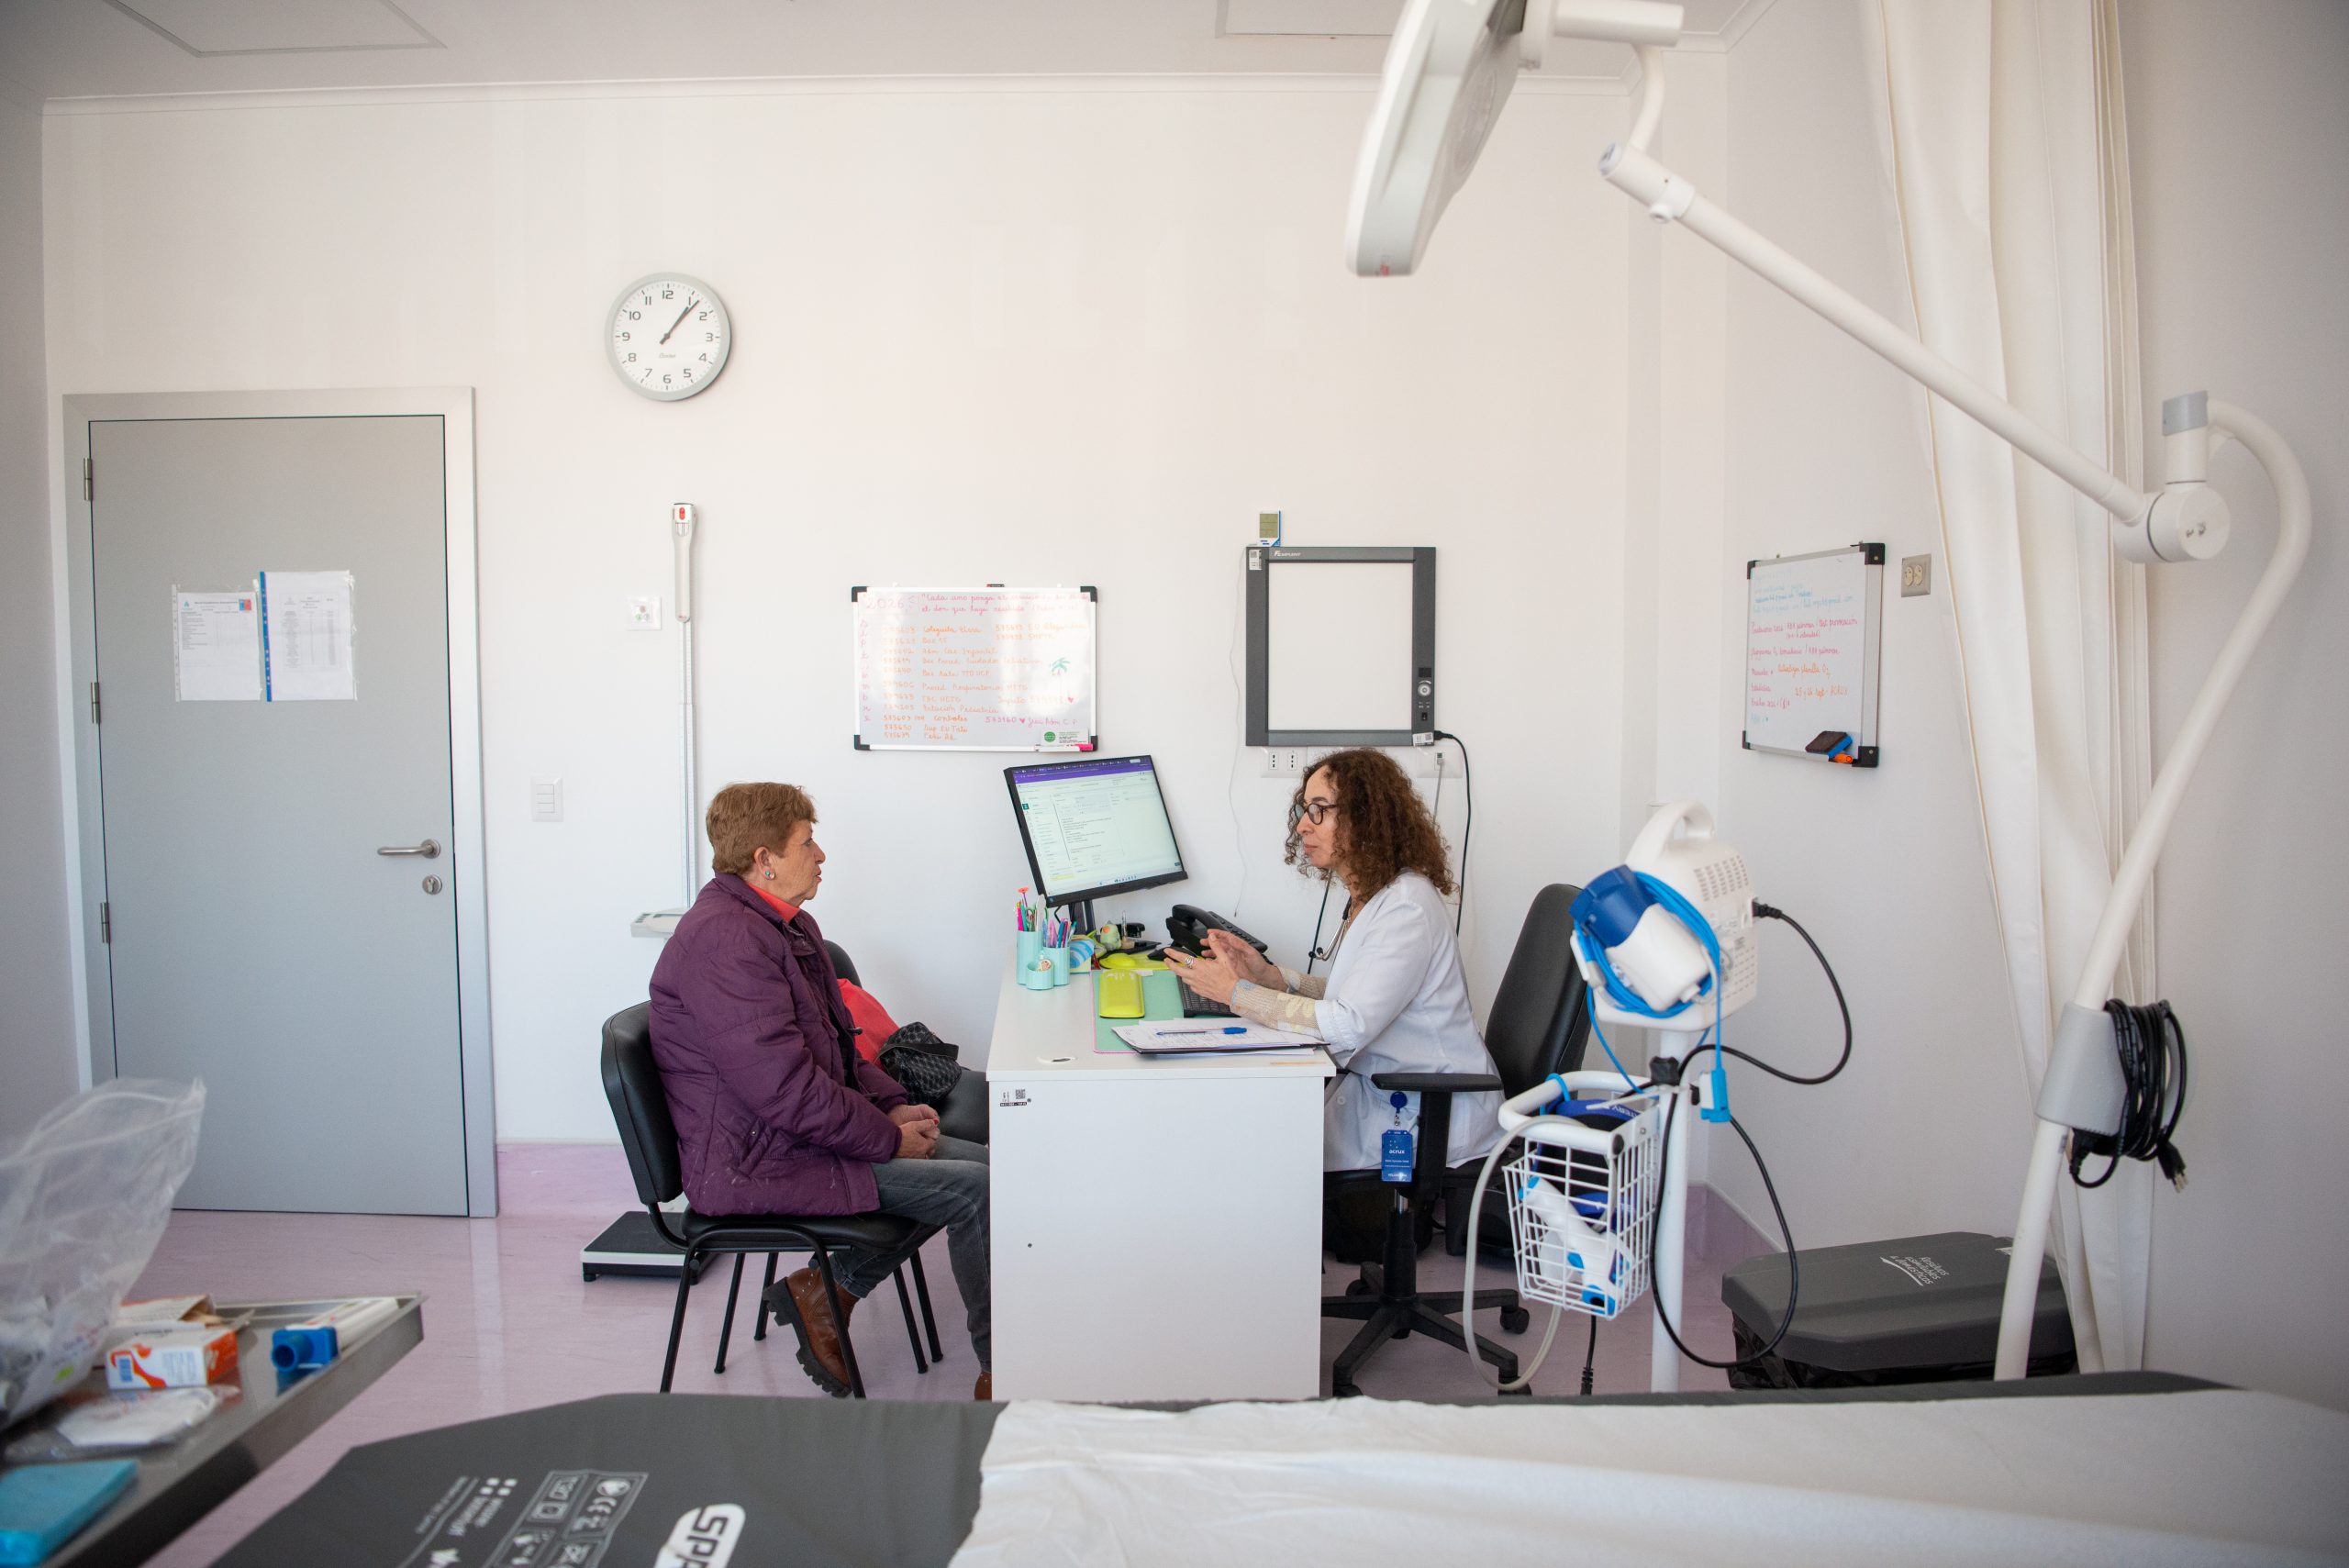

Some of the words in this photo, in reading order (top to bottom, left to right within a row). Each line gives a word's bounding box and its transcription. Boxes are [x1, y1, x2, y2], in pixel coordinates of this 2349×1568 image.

[662, 290, 674, 300] 12
[644, 295, 652, 306] 11
[629, 311, 641, 320] 10
[699, 311, 707, 321] 2
[622, 331, 630, 341] 9
[706, 332, 714, 342] 3
[628, 352, 637, 362] 8
[698, 352, 707, 362] 4
[645, 368, 652, 378] 7
[684, 368, 692, 378] 5
[662, 374, 672, 384] 6
